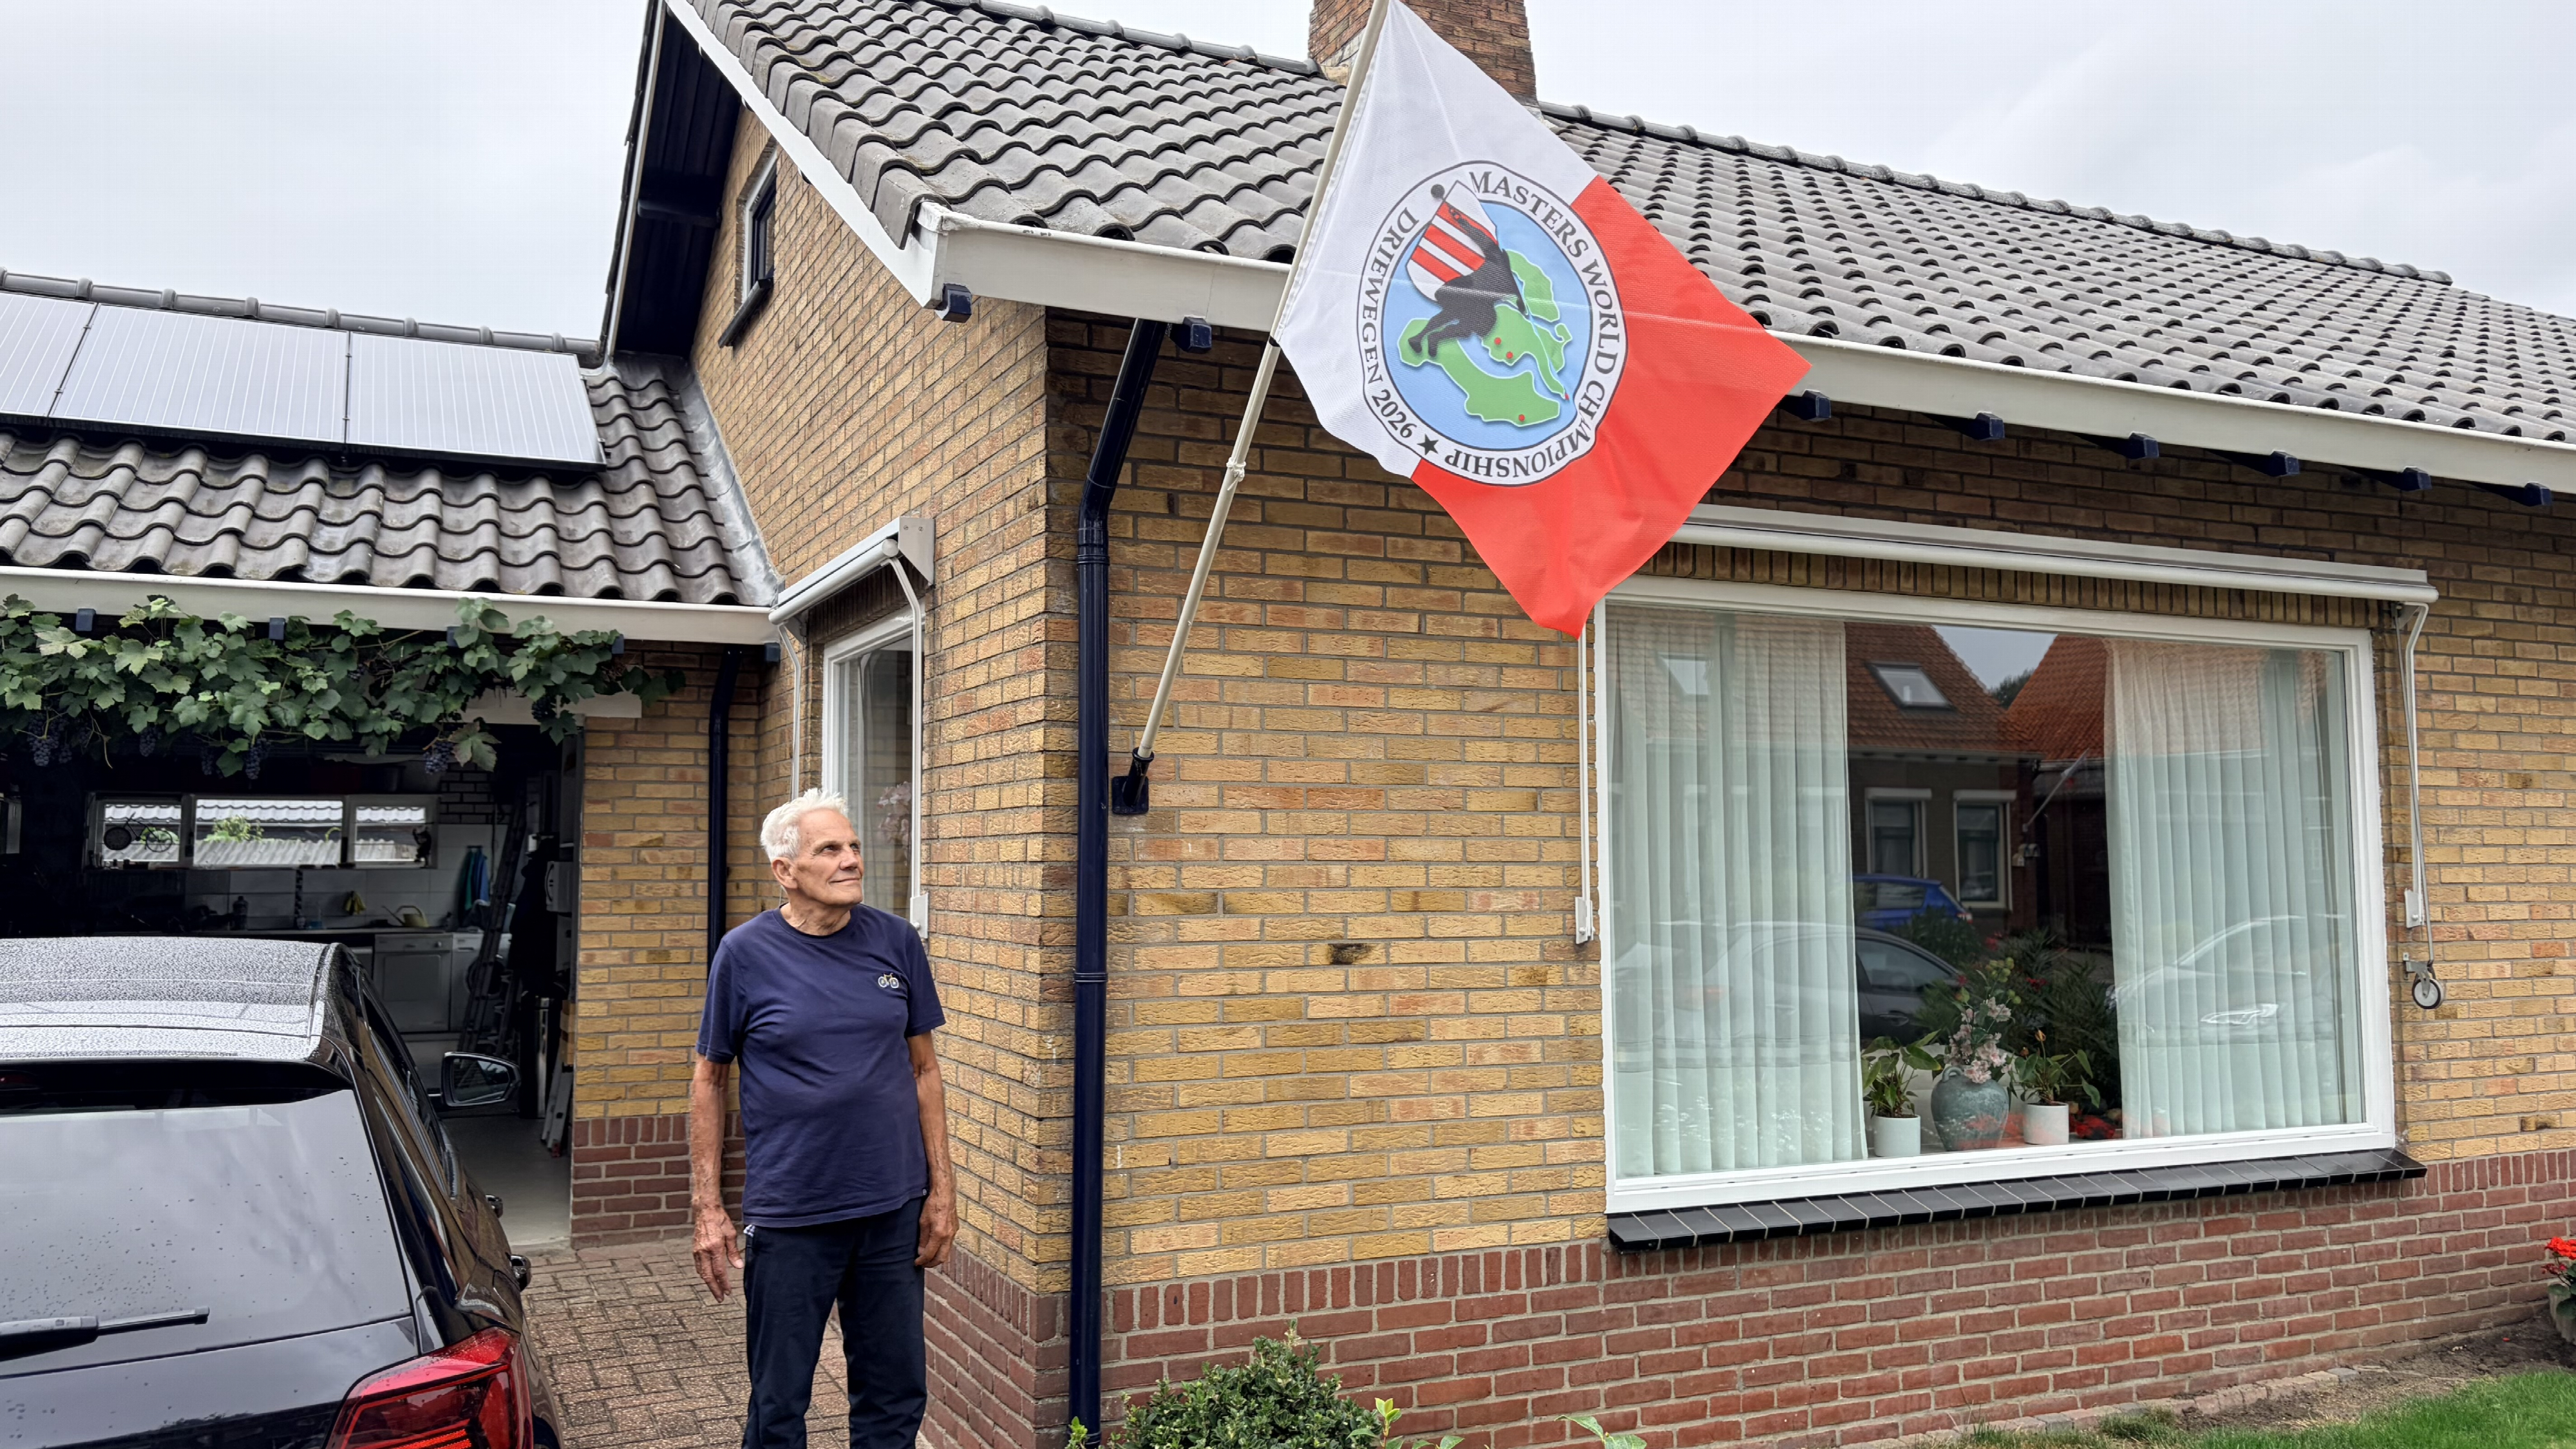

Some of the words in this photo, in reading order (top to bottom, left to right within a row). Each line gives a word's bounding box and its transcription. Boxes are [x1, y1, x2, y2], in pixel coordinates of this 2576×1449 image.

[1362, 207, 1419, 384] DRIEWEGEN
[1469, 171, 1589, 258] MASTERS
[1581, 259, 1620, 374] WORLD
[1372, 389, 1417, 439] 2026
